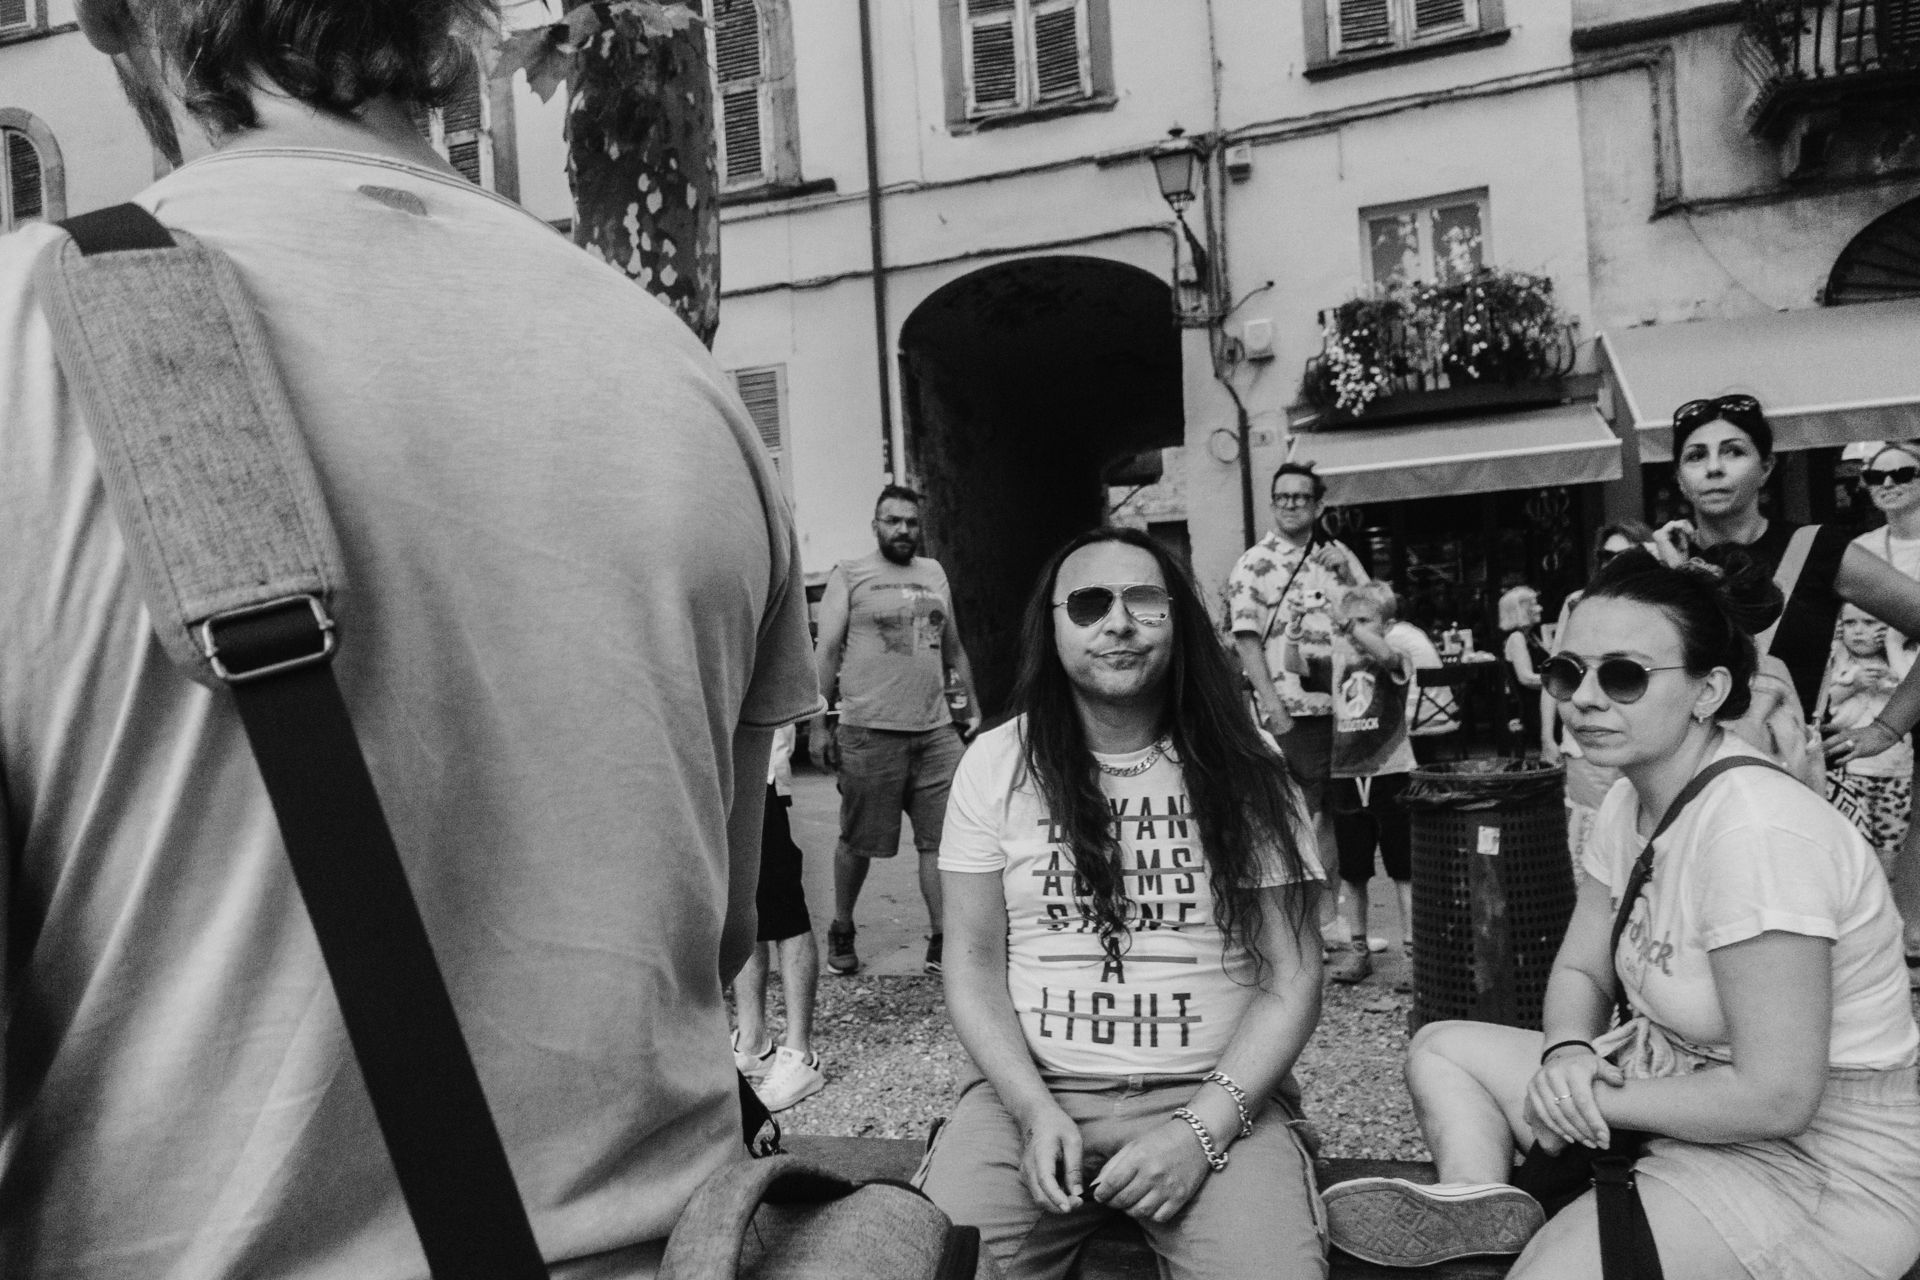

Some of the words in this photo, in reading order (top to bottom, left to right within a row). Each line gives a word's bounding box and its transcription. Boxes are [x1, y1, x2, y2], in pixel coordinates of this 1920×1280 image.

[1042, 848, 1196, 897] AMS
[1100, 936, 1126, 983] A
[1040, 986, 1191, 1047] LIGHT
